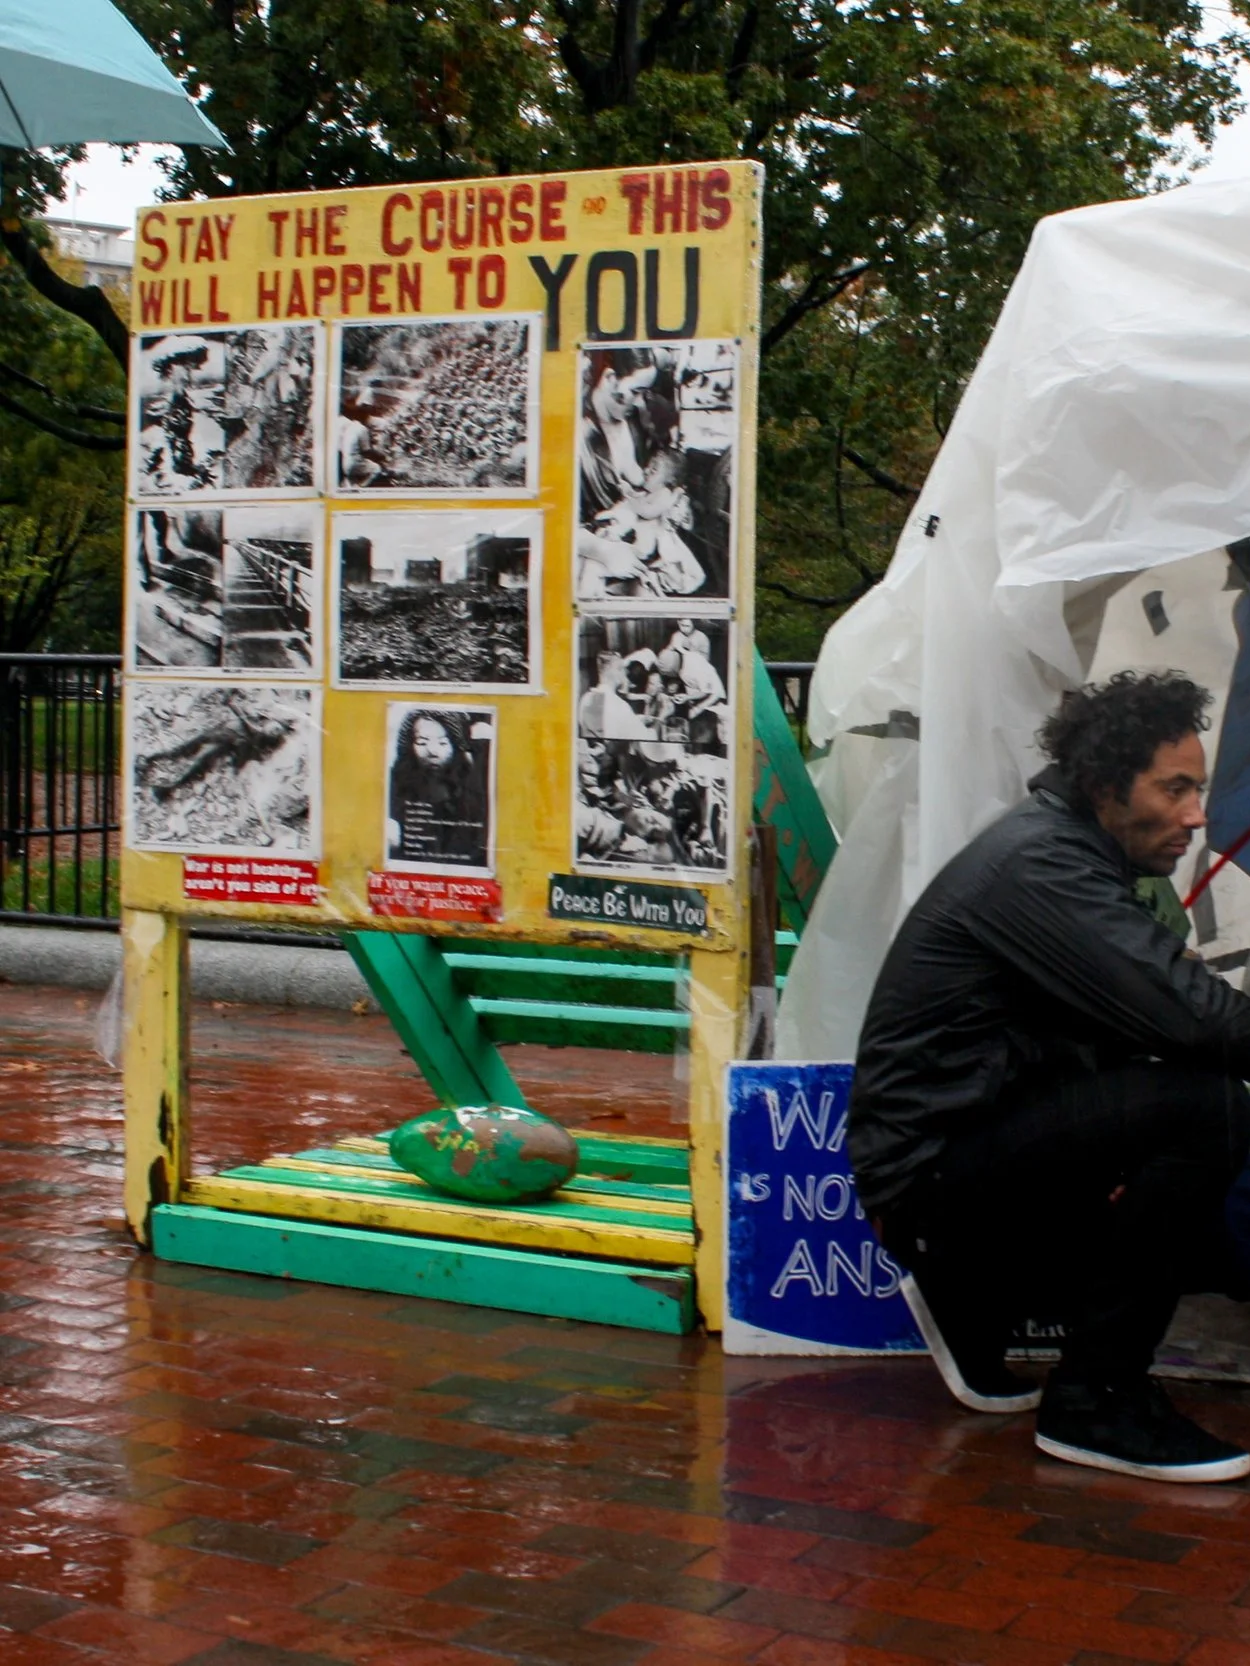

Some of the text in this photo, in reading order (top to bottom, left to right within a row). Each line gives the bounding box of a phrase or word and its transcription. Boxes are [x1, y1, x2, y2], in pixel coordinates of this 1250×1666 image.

[141, 210, 236, 272] STAY
[268, 204, 348, 258] THE
[381, 181, 566, 257] COURSE
[620, 168, 731, 235] THIS
[139, 247, 699, 351] WILL HAPPEN TO YOU
[212, 862, 224, 873] is
[227, 880, 250, 893] you
[253, 880, 280, 894] sick
[282, 882, 297, 894] of
[412, 880, 445, 893] want
[742, 1174, 770, 1200] IS
